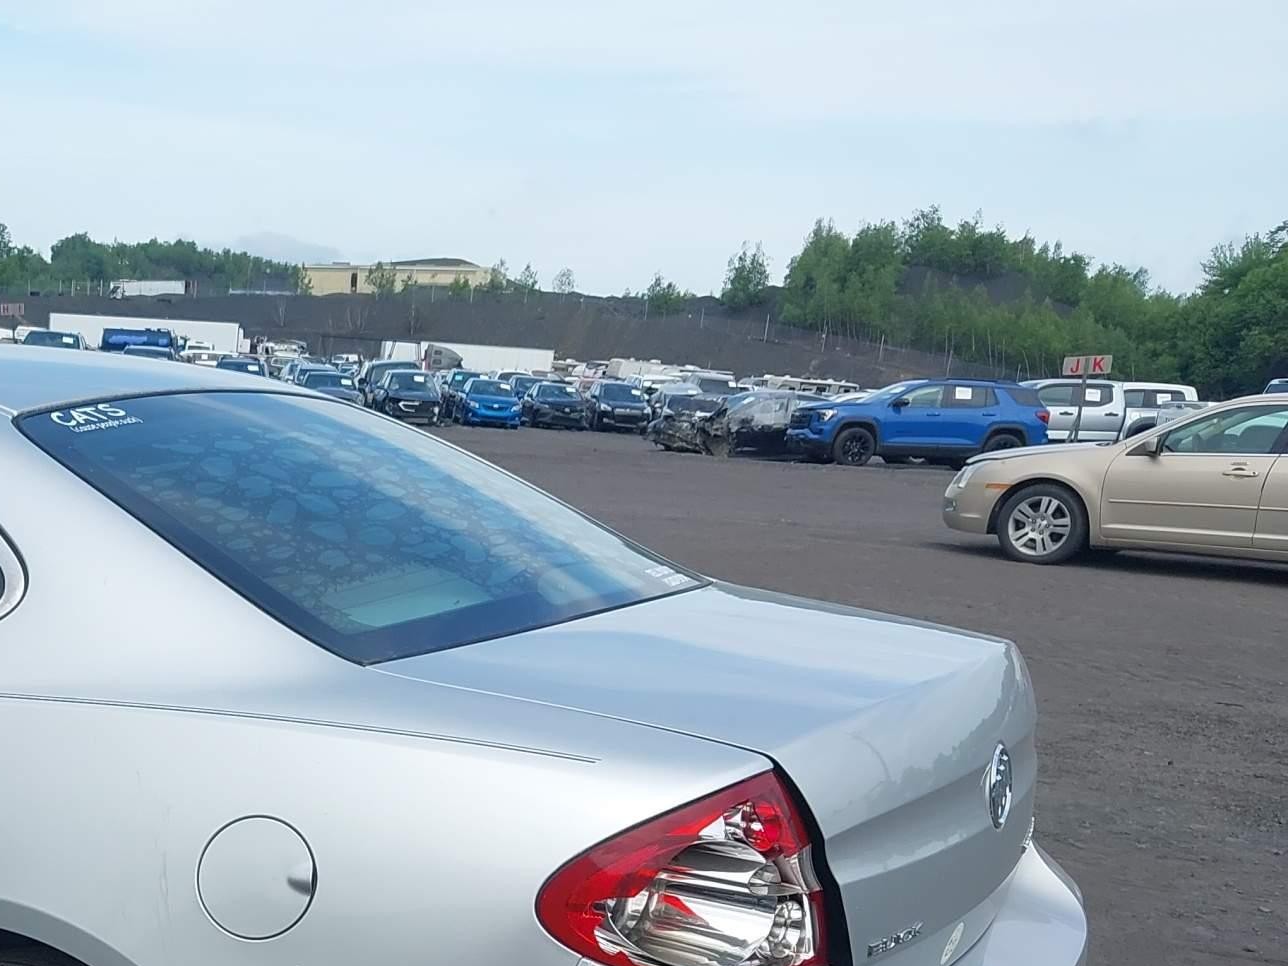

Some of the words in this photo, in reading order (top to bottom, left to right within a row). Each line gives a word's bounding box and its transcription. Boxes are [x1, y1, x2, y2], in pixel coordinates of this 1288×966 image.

[1070, 358, 1081, 374] J
[1092, 357, 1105, 373] K
[50, 403, 126, 426] CATS
